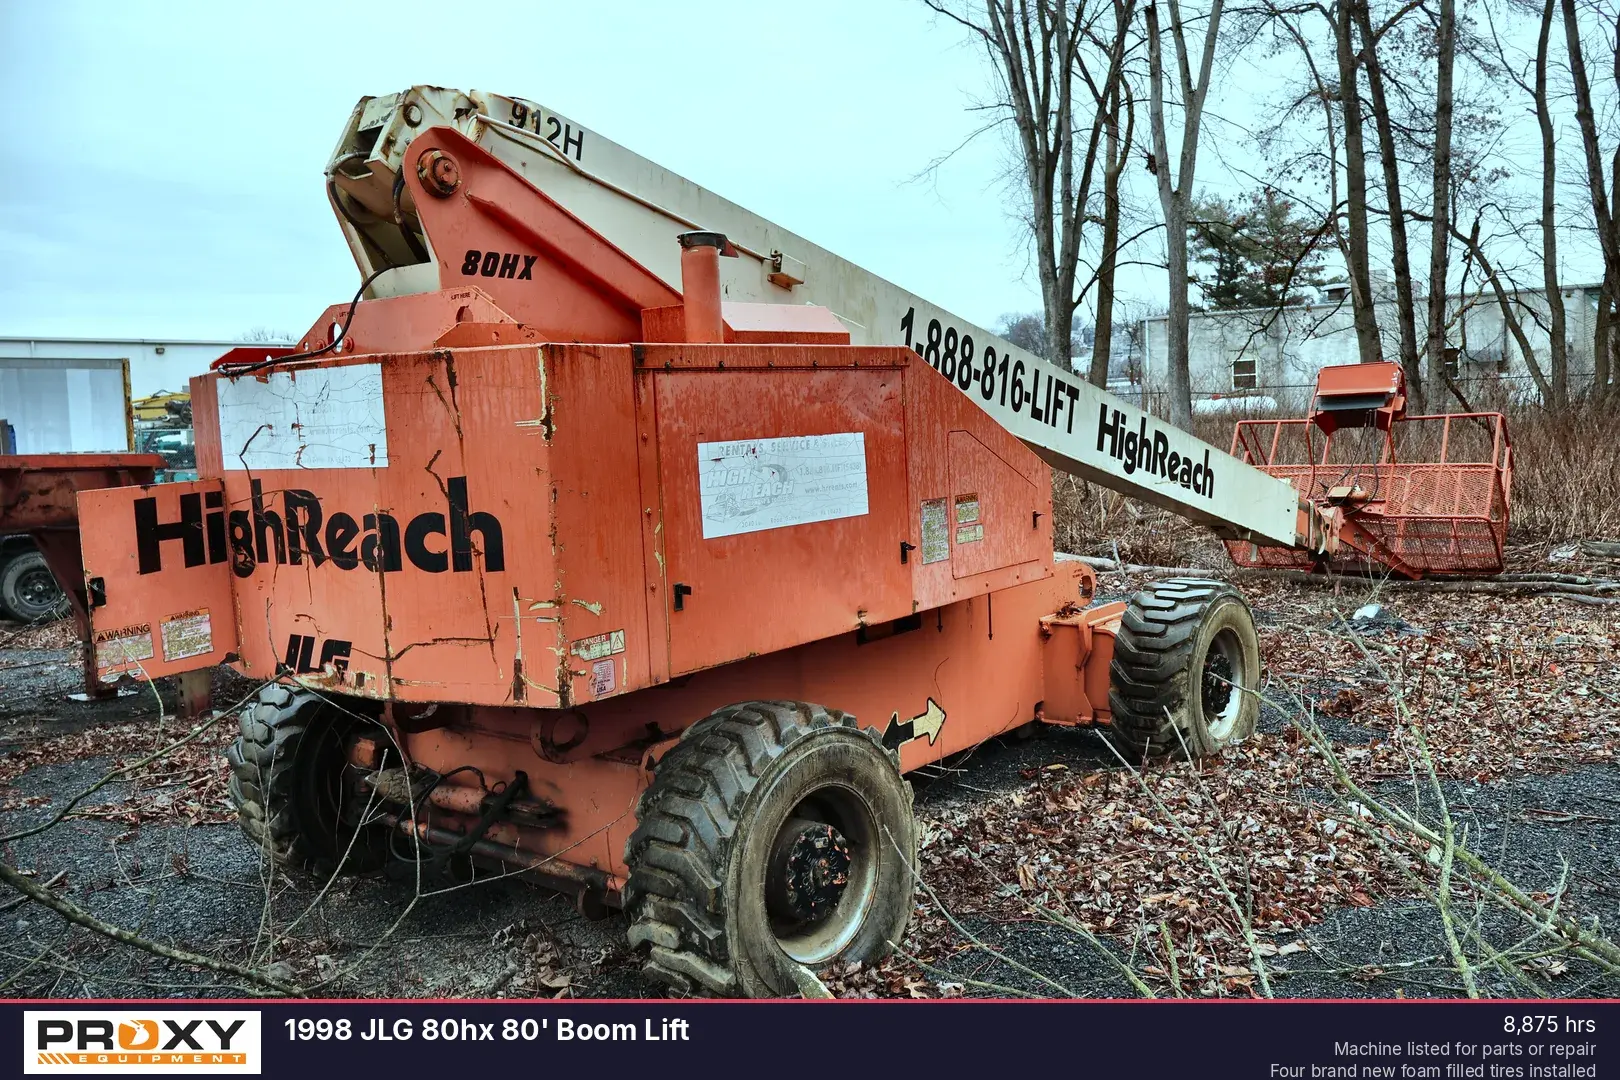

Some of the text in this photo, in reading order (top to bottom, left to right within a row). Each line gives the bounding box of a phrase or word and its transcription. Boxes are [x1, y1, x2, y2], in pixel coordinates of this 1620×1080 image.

[508, 101, 583, 161] 912H
[461, 250, 538, 281] 80HX
[900, 307, 1080, 435] 1-888-816-LIFT
[1097, 403, 1214, 499] HighReach
[706, 467, 753, 489] HIGH
[740, 480, 795, 500] REACH
[134, 476, 505, 578] HighReach
[105, 624, 150, 641] WARNING
[581, 635, 606, 646] DANGER
[275, 634, 352, 684] JLG
